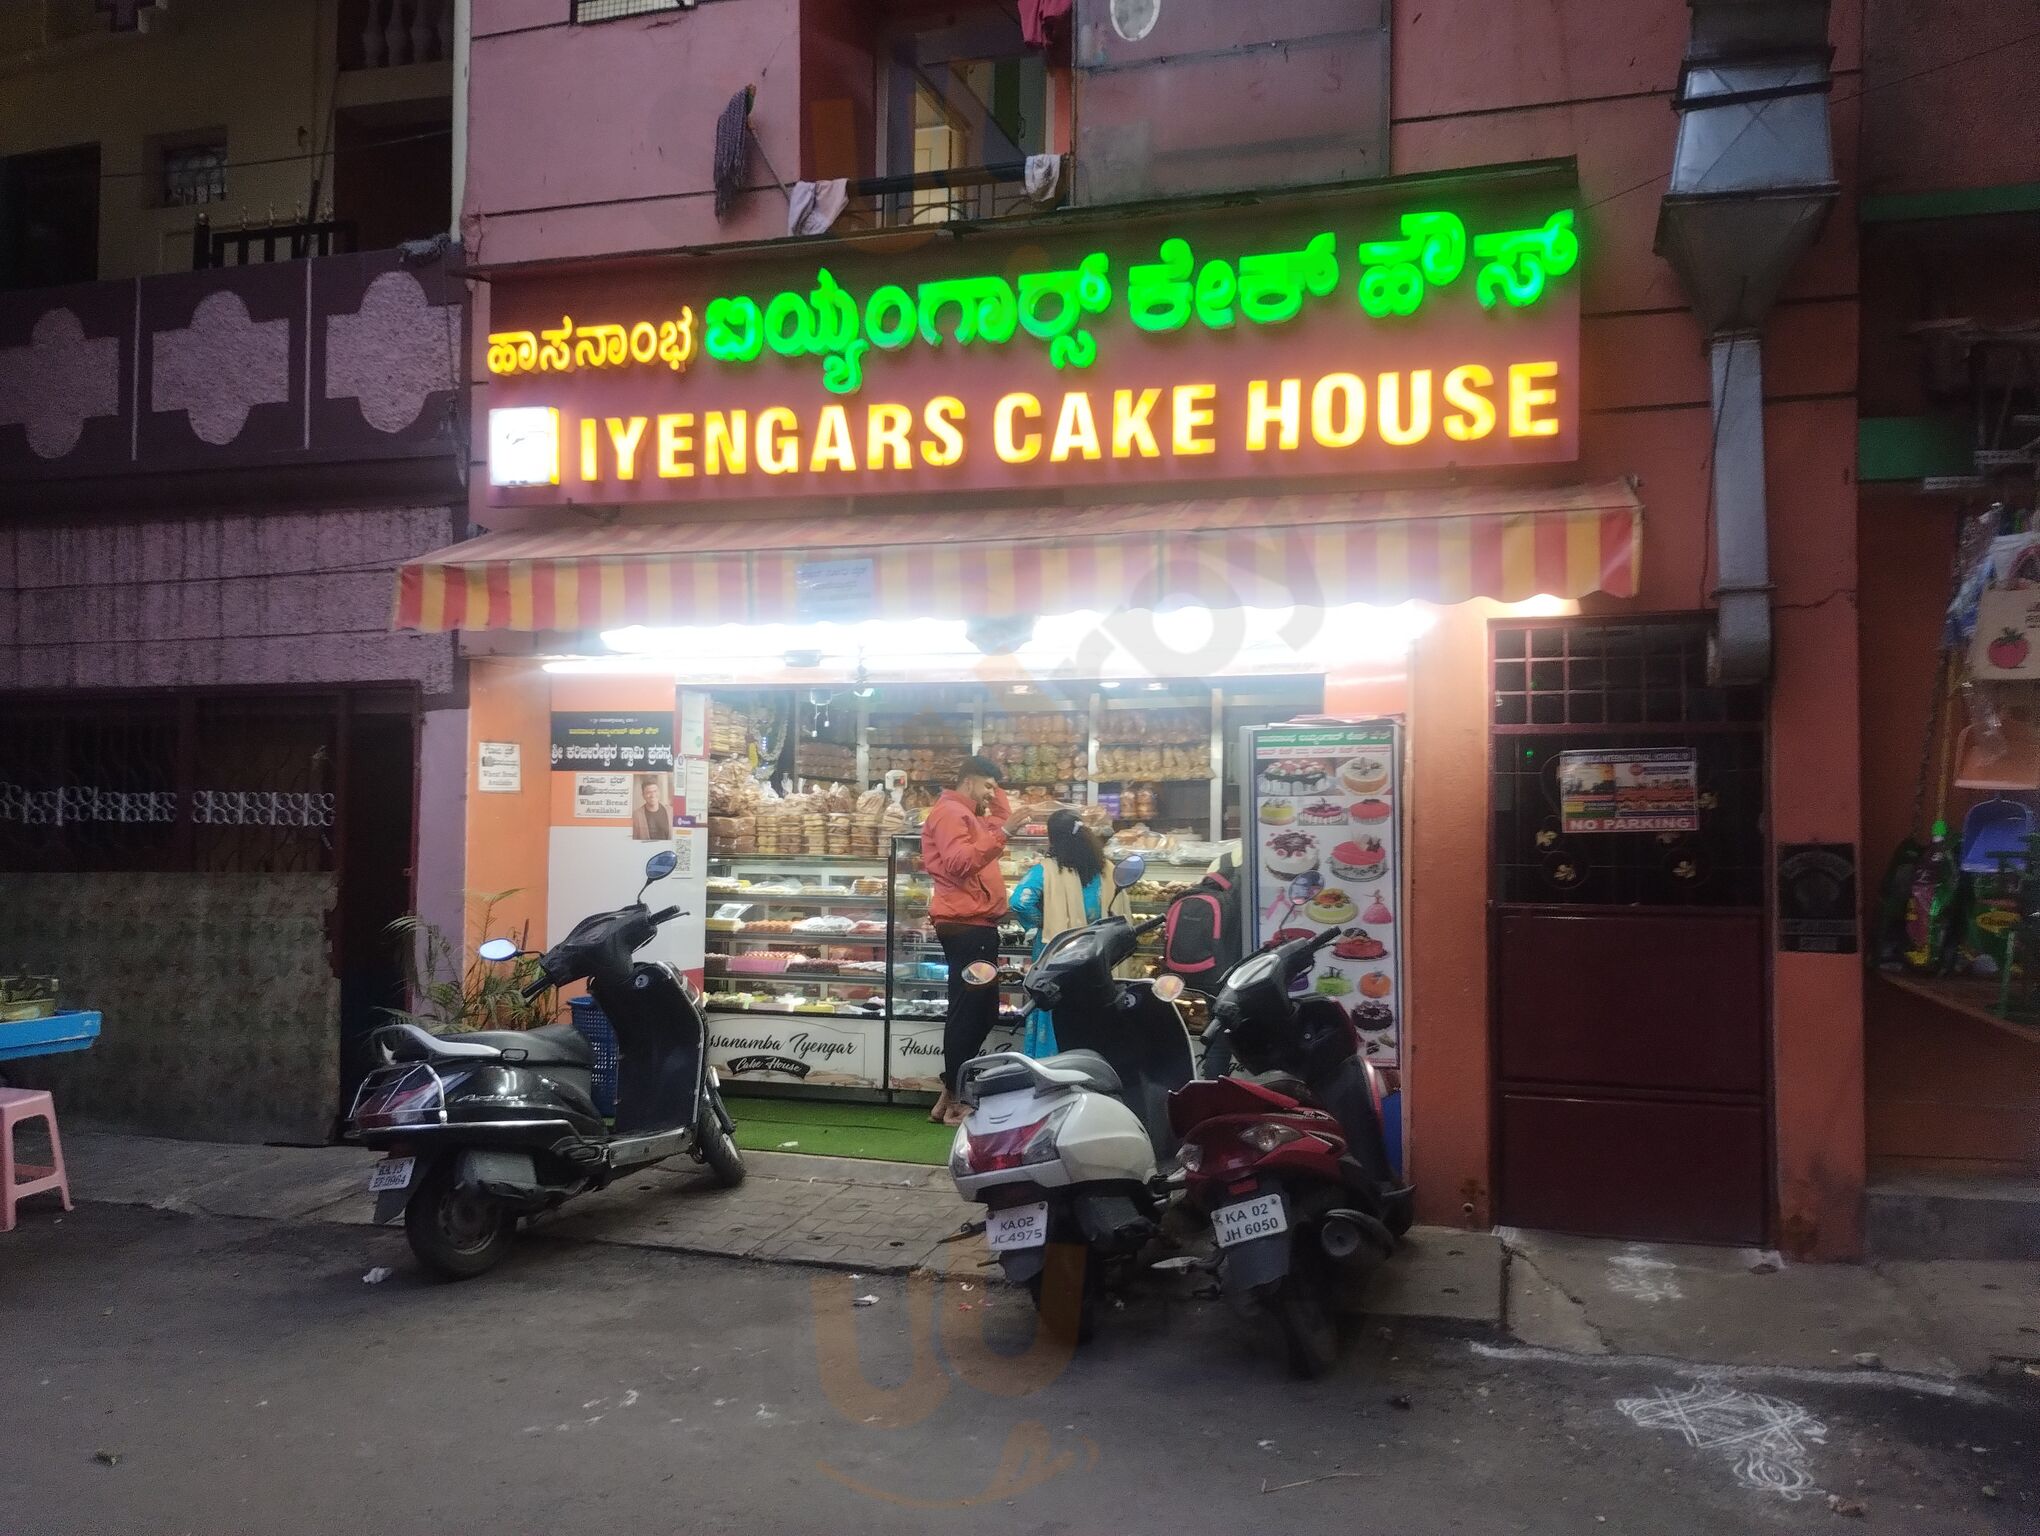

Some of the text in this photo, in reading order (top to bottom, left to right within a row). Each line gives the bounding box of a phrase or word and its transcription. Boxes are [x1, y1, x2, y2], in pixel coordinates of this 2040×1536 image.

[1128, 232, 1339, 333] ಕೇಕ್
[579, 361, 1560, 482] IYENGARS CAKE HOUSE
[579, 798, 628, 807] Wheat Bread
[585, 806, 621, 815] Available
[1570, 817, 1691, 830] NO PARKING
[709, 1034, 786, 1051] ssanamba
[735, 1056, 802, 1072] Cake House
[1225, 1202, 1269, 1225] KA 02
[1224, 1216, 1279, 1243] JH 6050
